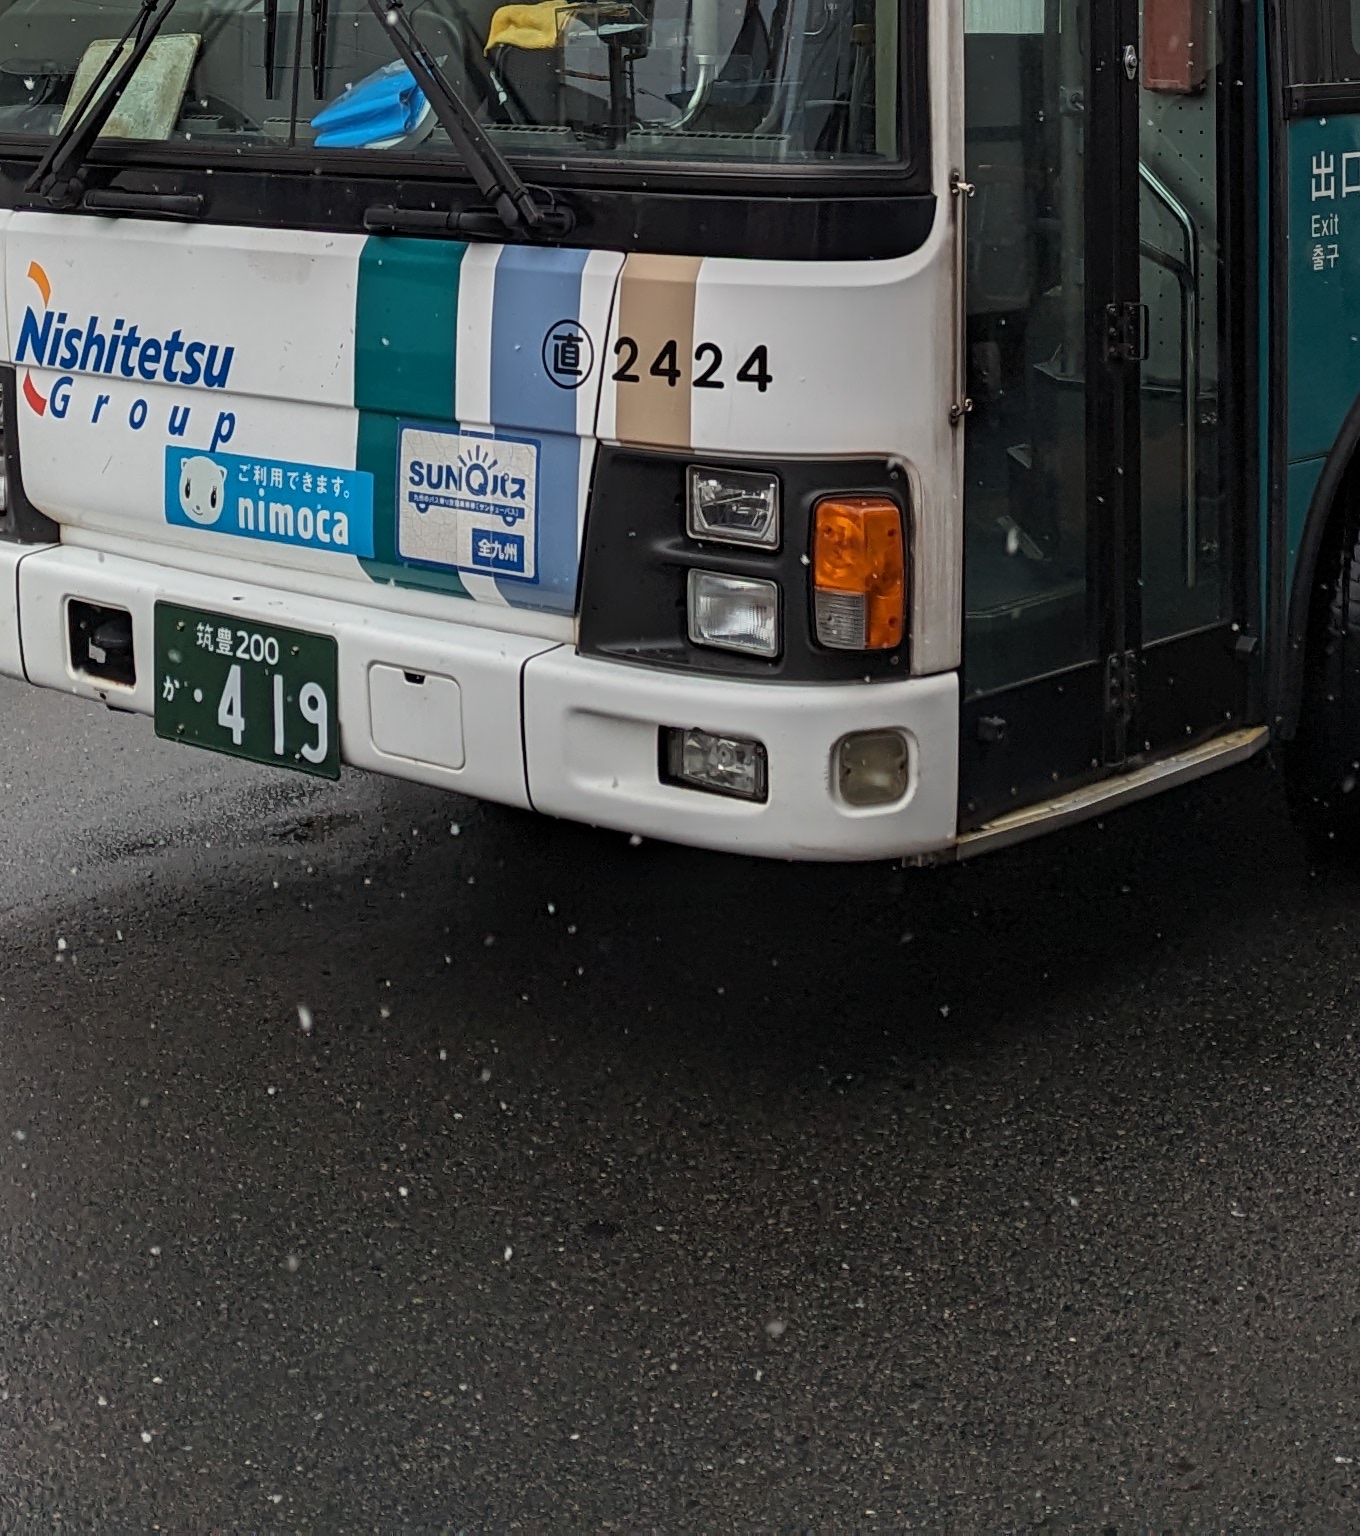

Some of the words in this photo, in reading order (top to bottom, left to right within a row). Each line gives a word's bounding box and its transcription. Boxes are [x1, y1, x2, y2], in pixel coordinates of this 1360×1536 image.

[1311, 213, 1339, 238] Exit
[1312, 244, 1340, 271] 출구
[15, 305, 235, 389] Nishitetsu
[612, 338, 773, 392] 2424
[49, 377, 237, 453] Group
[238, 488, 350, 546] nimoca
[477, 538, 519, 563] 全九州
